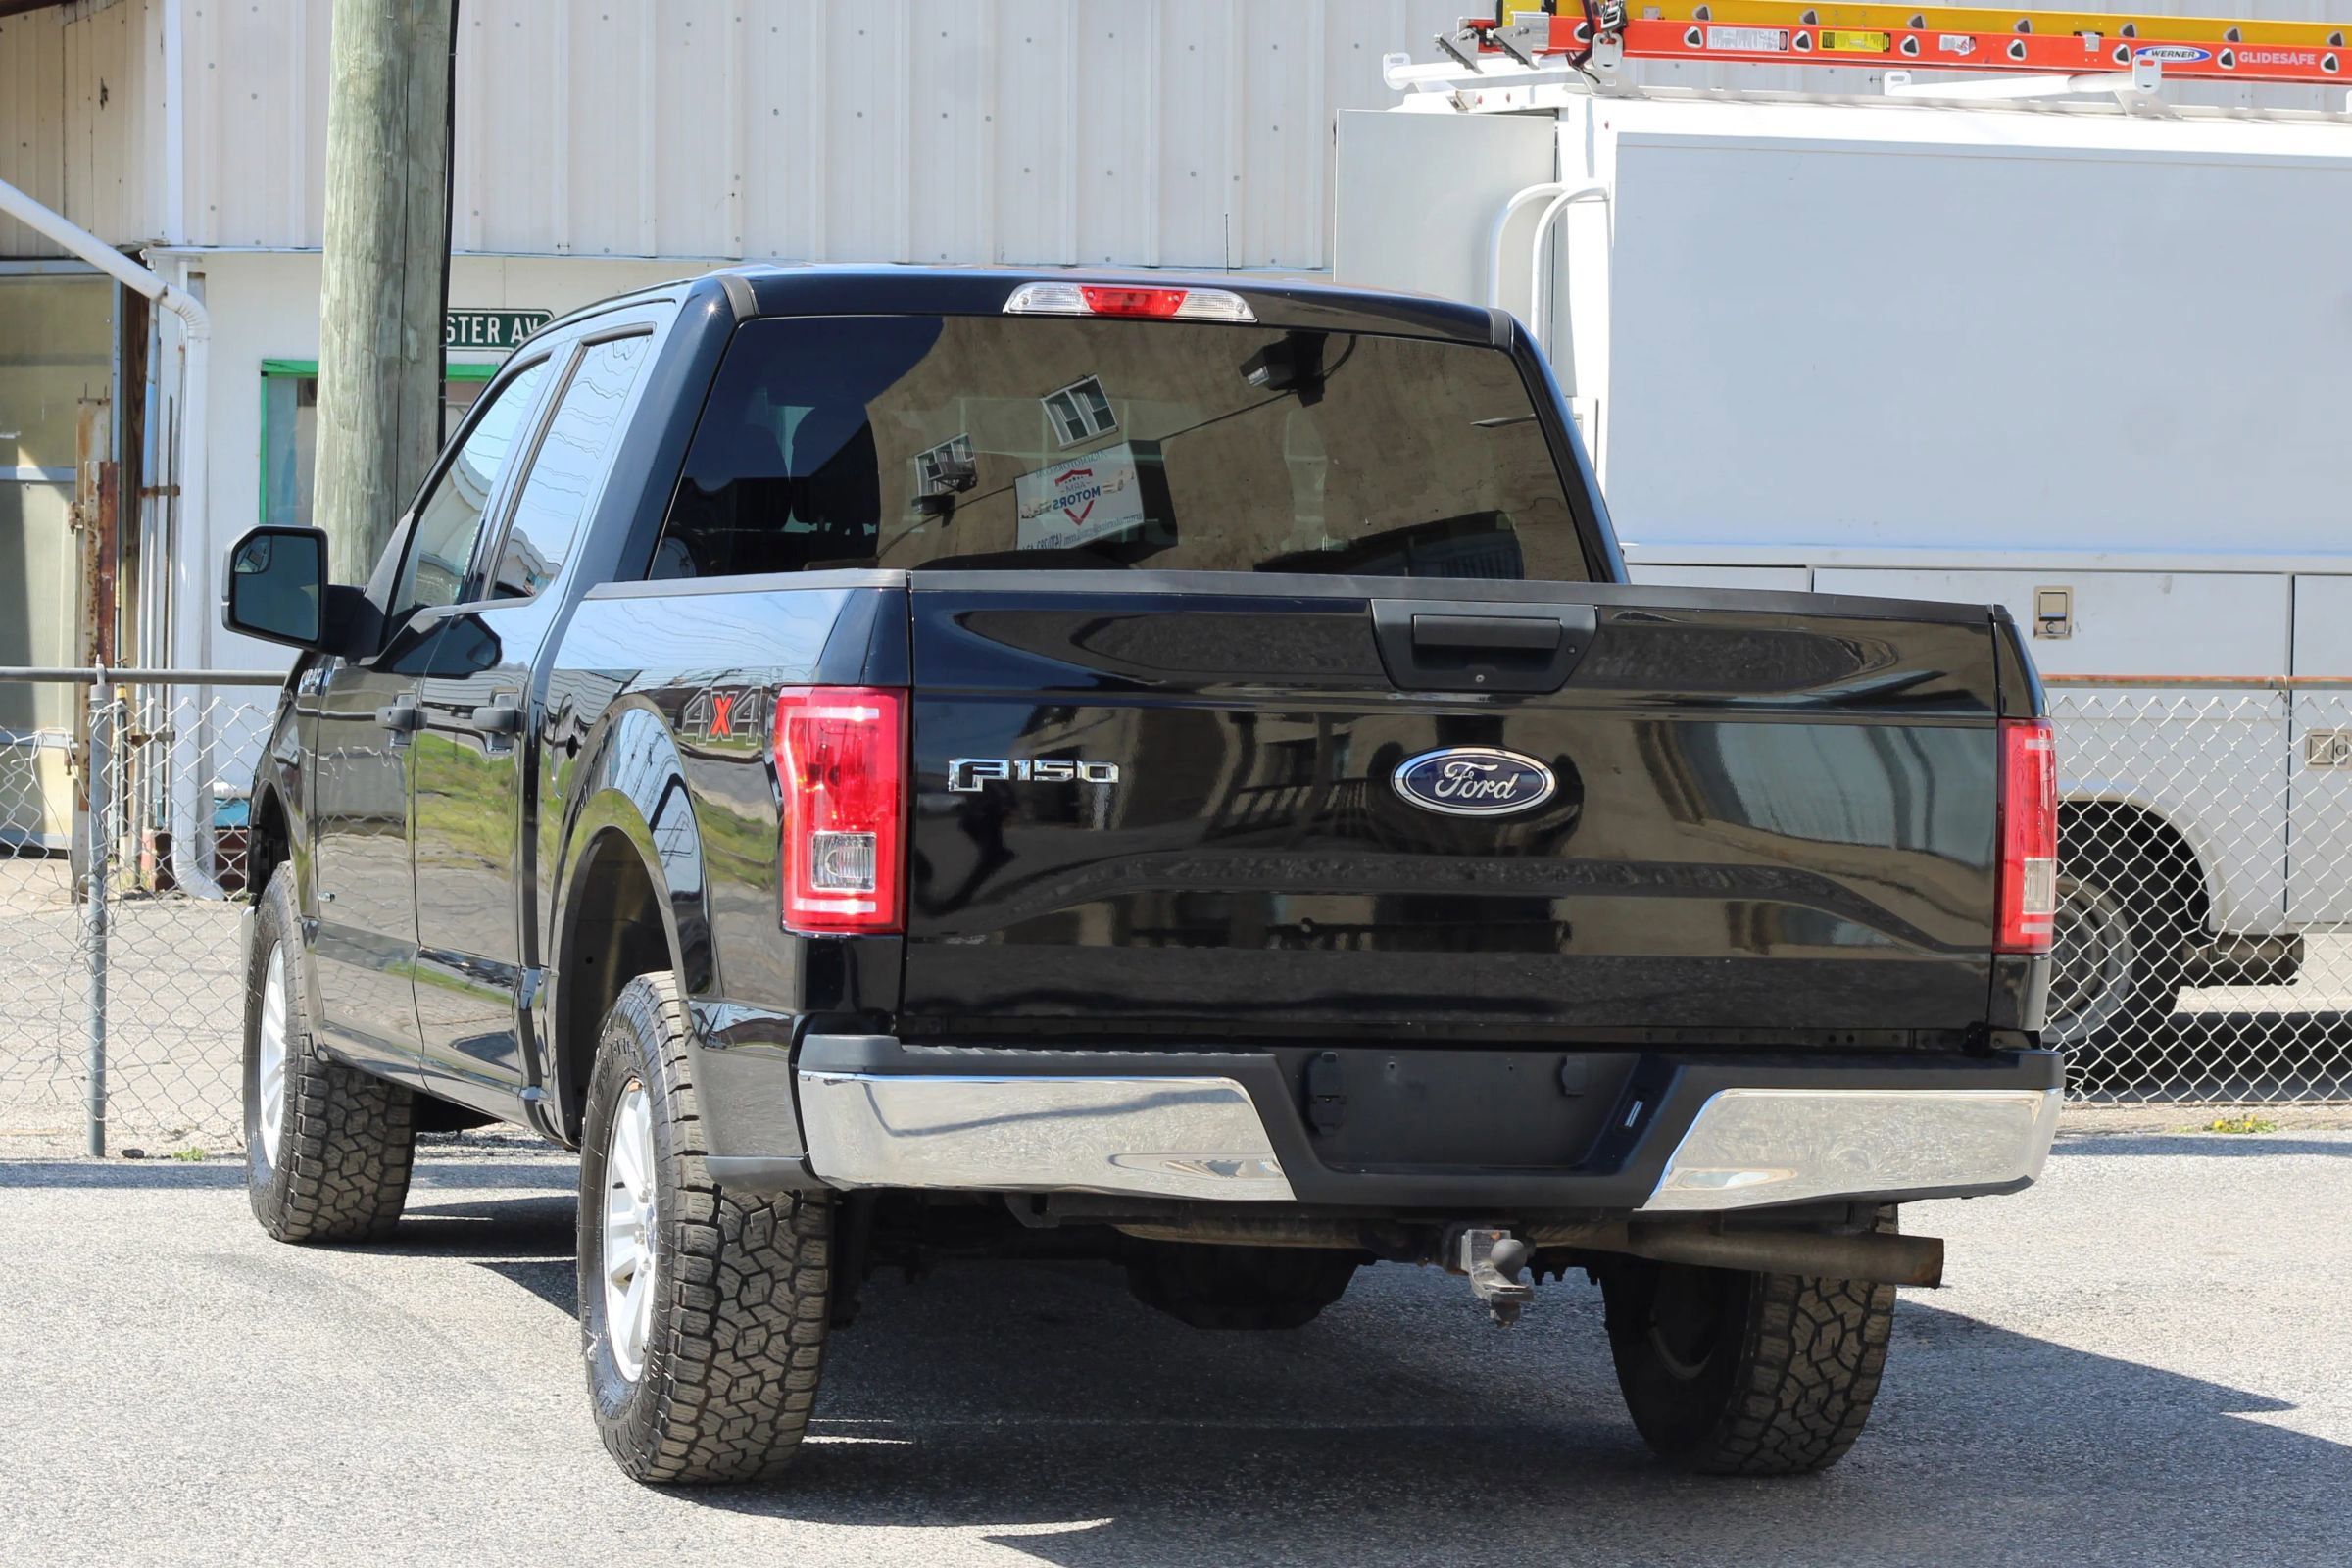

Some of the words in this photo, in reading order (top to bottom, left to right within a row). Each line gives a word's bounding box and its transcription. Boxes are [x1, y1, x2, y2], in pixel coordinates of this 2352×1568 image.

[2150, 50, 2196, 59] WERNER
[2239, 51, 2316, 65] GLIDESAFE
[1434, 761, 1520, 801] Ford
